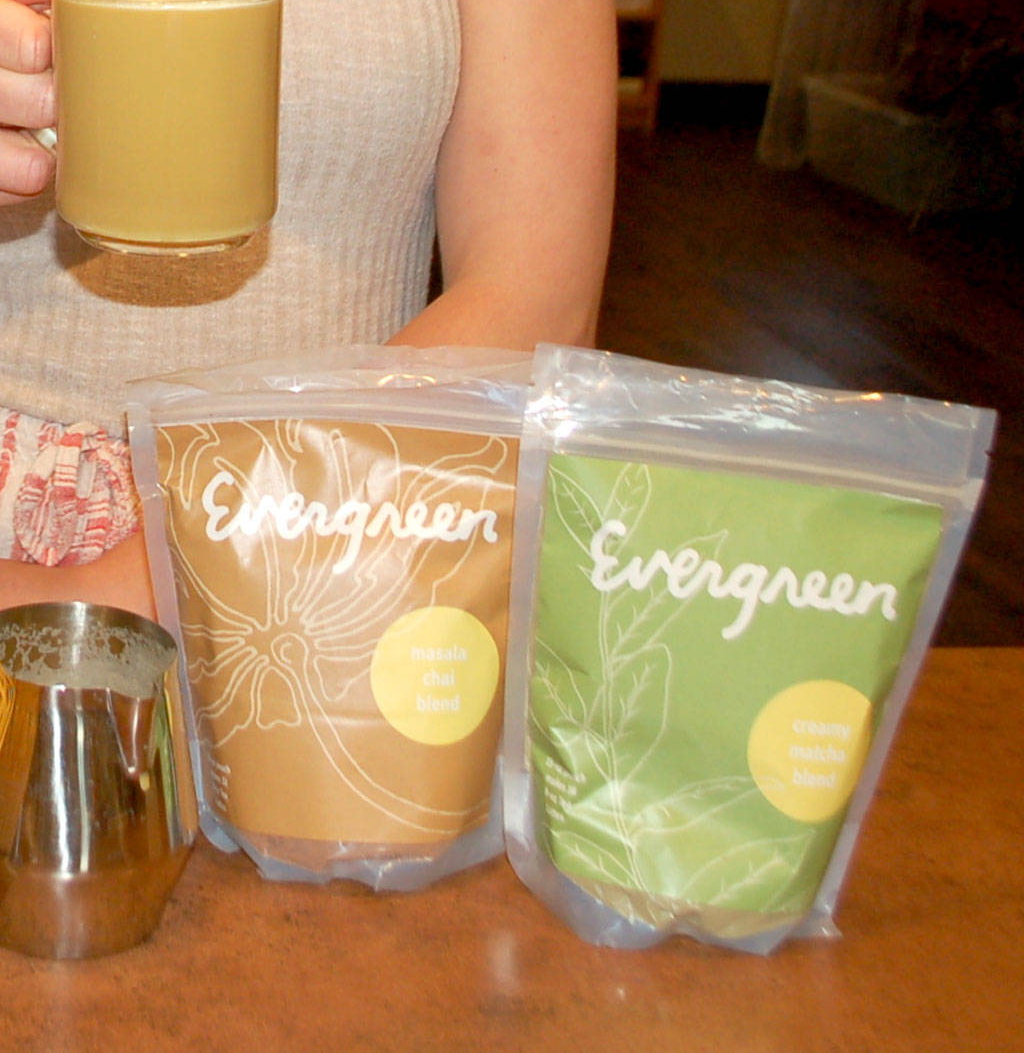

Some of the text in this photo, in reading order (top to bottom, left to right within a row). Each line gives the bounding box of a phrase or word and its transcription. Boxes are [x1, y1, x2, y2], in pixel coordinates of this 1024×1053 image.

[202, 471, 498, 574] Evergreen
[590, 520, 897, 640] Evergreen
[410, 643, 468, 661] masala
[422, 668, 456, 686] chai
[416, 693, 461, 712] blend
[792, 719, 851, 742] creamy
[789, 744, 846, 763] matcha
[792, 767, 837, 788] blend
